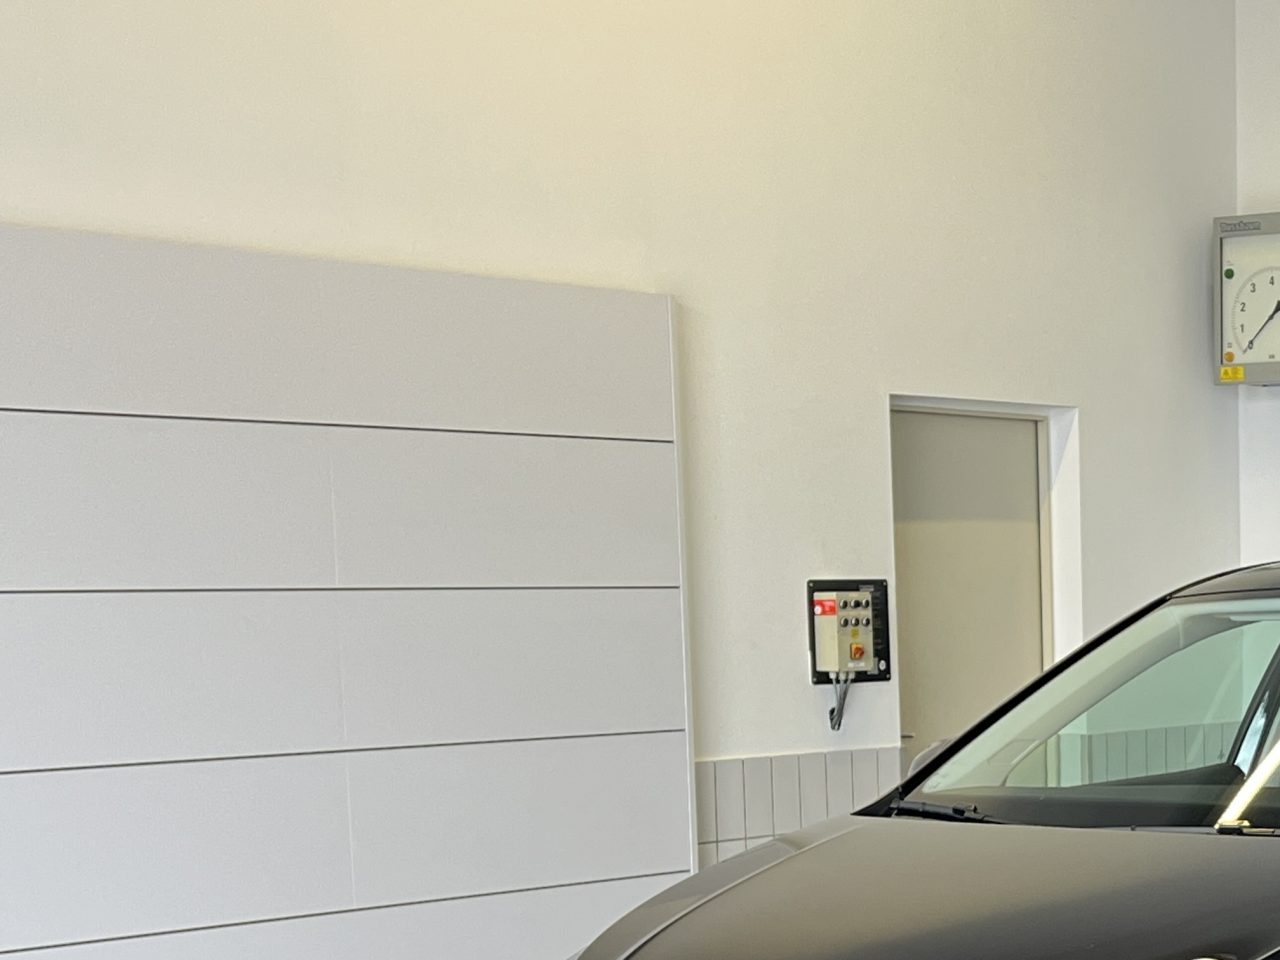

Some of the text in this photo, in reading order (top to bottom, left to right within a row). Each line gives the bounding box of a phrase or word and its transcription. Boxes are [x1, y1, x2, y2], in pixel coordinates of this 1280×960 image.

[1269, 276, 1275, 286] 4
[1250, 282, 1256, 293] 3
[1240, 302, 1246, 312] 2
